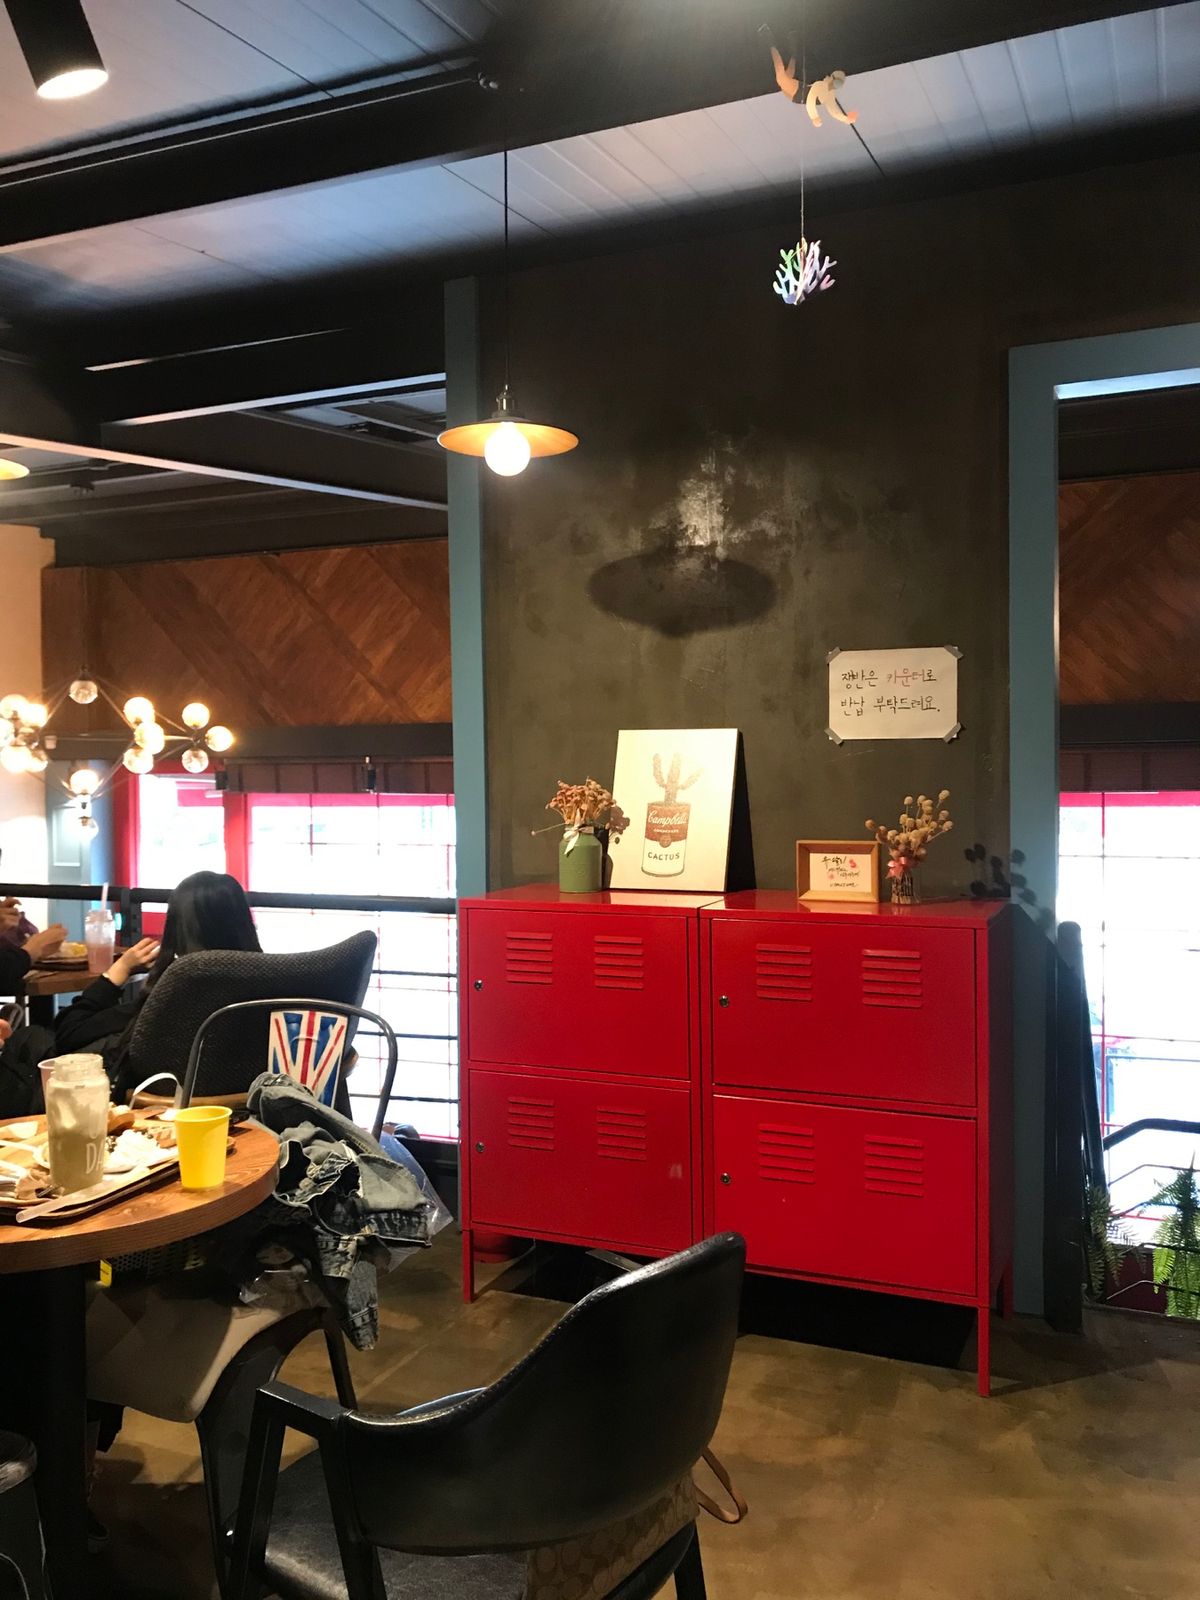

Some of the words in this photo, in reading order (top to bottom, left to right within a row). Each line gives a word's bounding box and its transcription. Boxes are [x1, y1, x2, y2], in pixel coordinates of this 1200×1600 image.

[841, 669, 879, 689] 쟁반은
[840, 696, 865, 716] 반납
[647, 851, 680, 861] CACTUS
